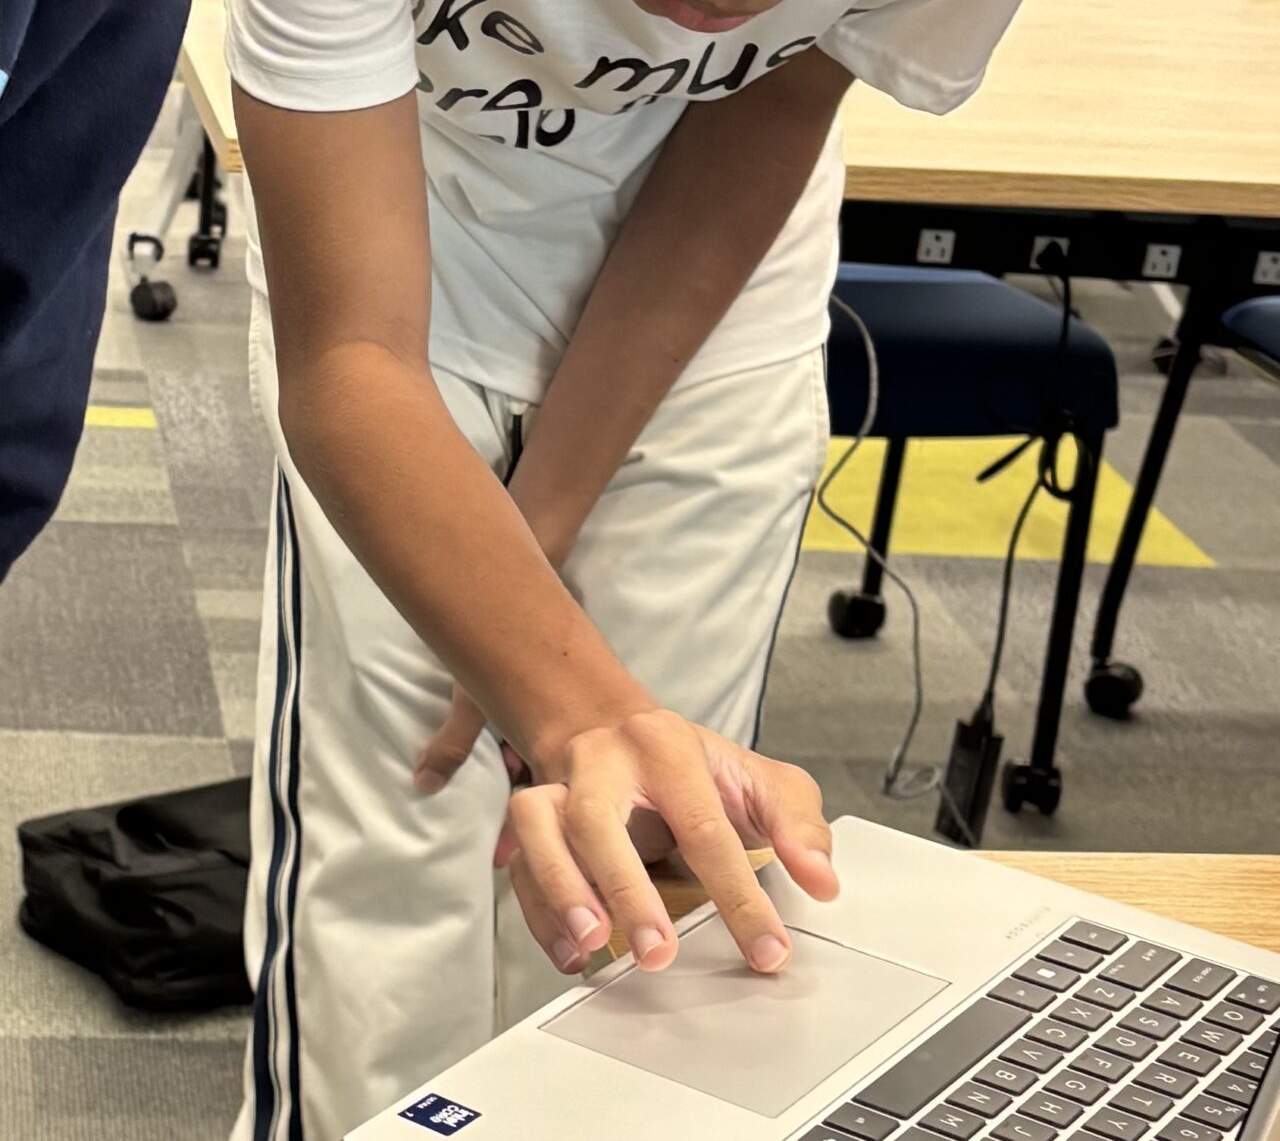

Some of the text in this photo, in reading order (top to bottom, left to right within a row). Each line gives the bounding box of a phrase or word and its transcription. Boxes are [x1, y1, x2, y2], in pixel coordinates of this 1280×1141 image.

[939, 986, 1116, 1127] Z X C V B N M
[1014, 996, 1181, 1138] A S D F G H J
[1107, 1011, 1244, 1131] Q W E R T Y
[1227, 1084, 1244, 1093] 4
[1179, 1129, 1199, 1139] 6
[1204, 1105, 1222, 1116] 5
